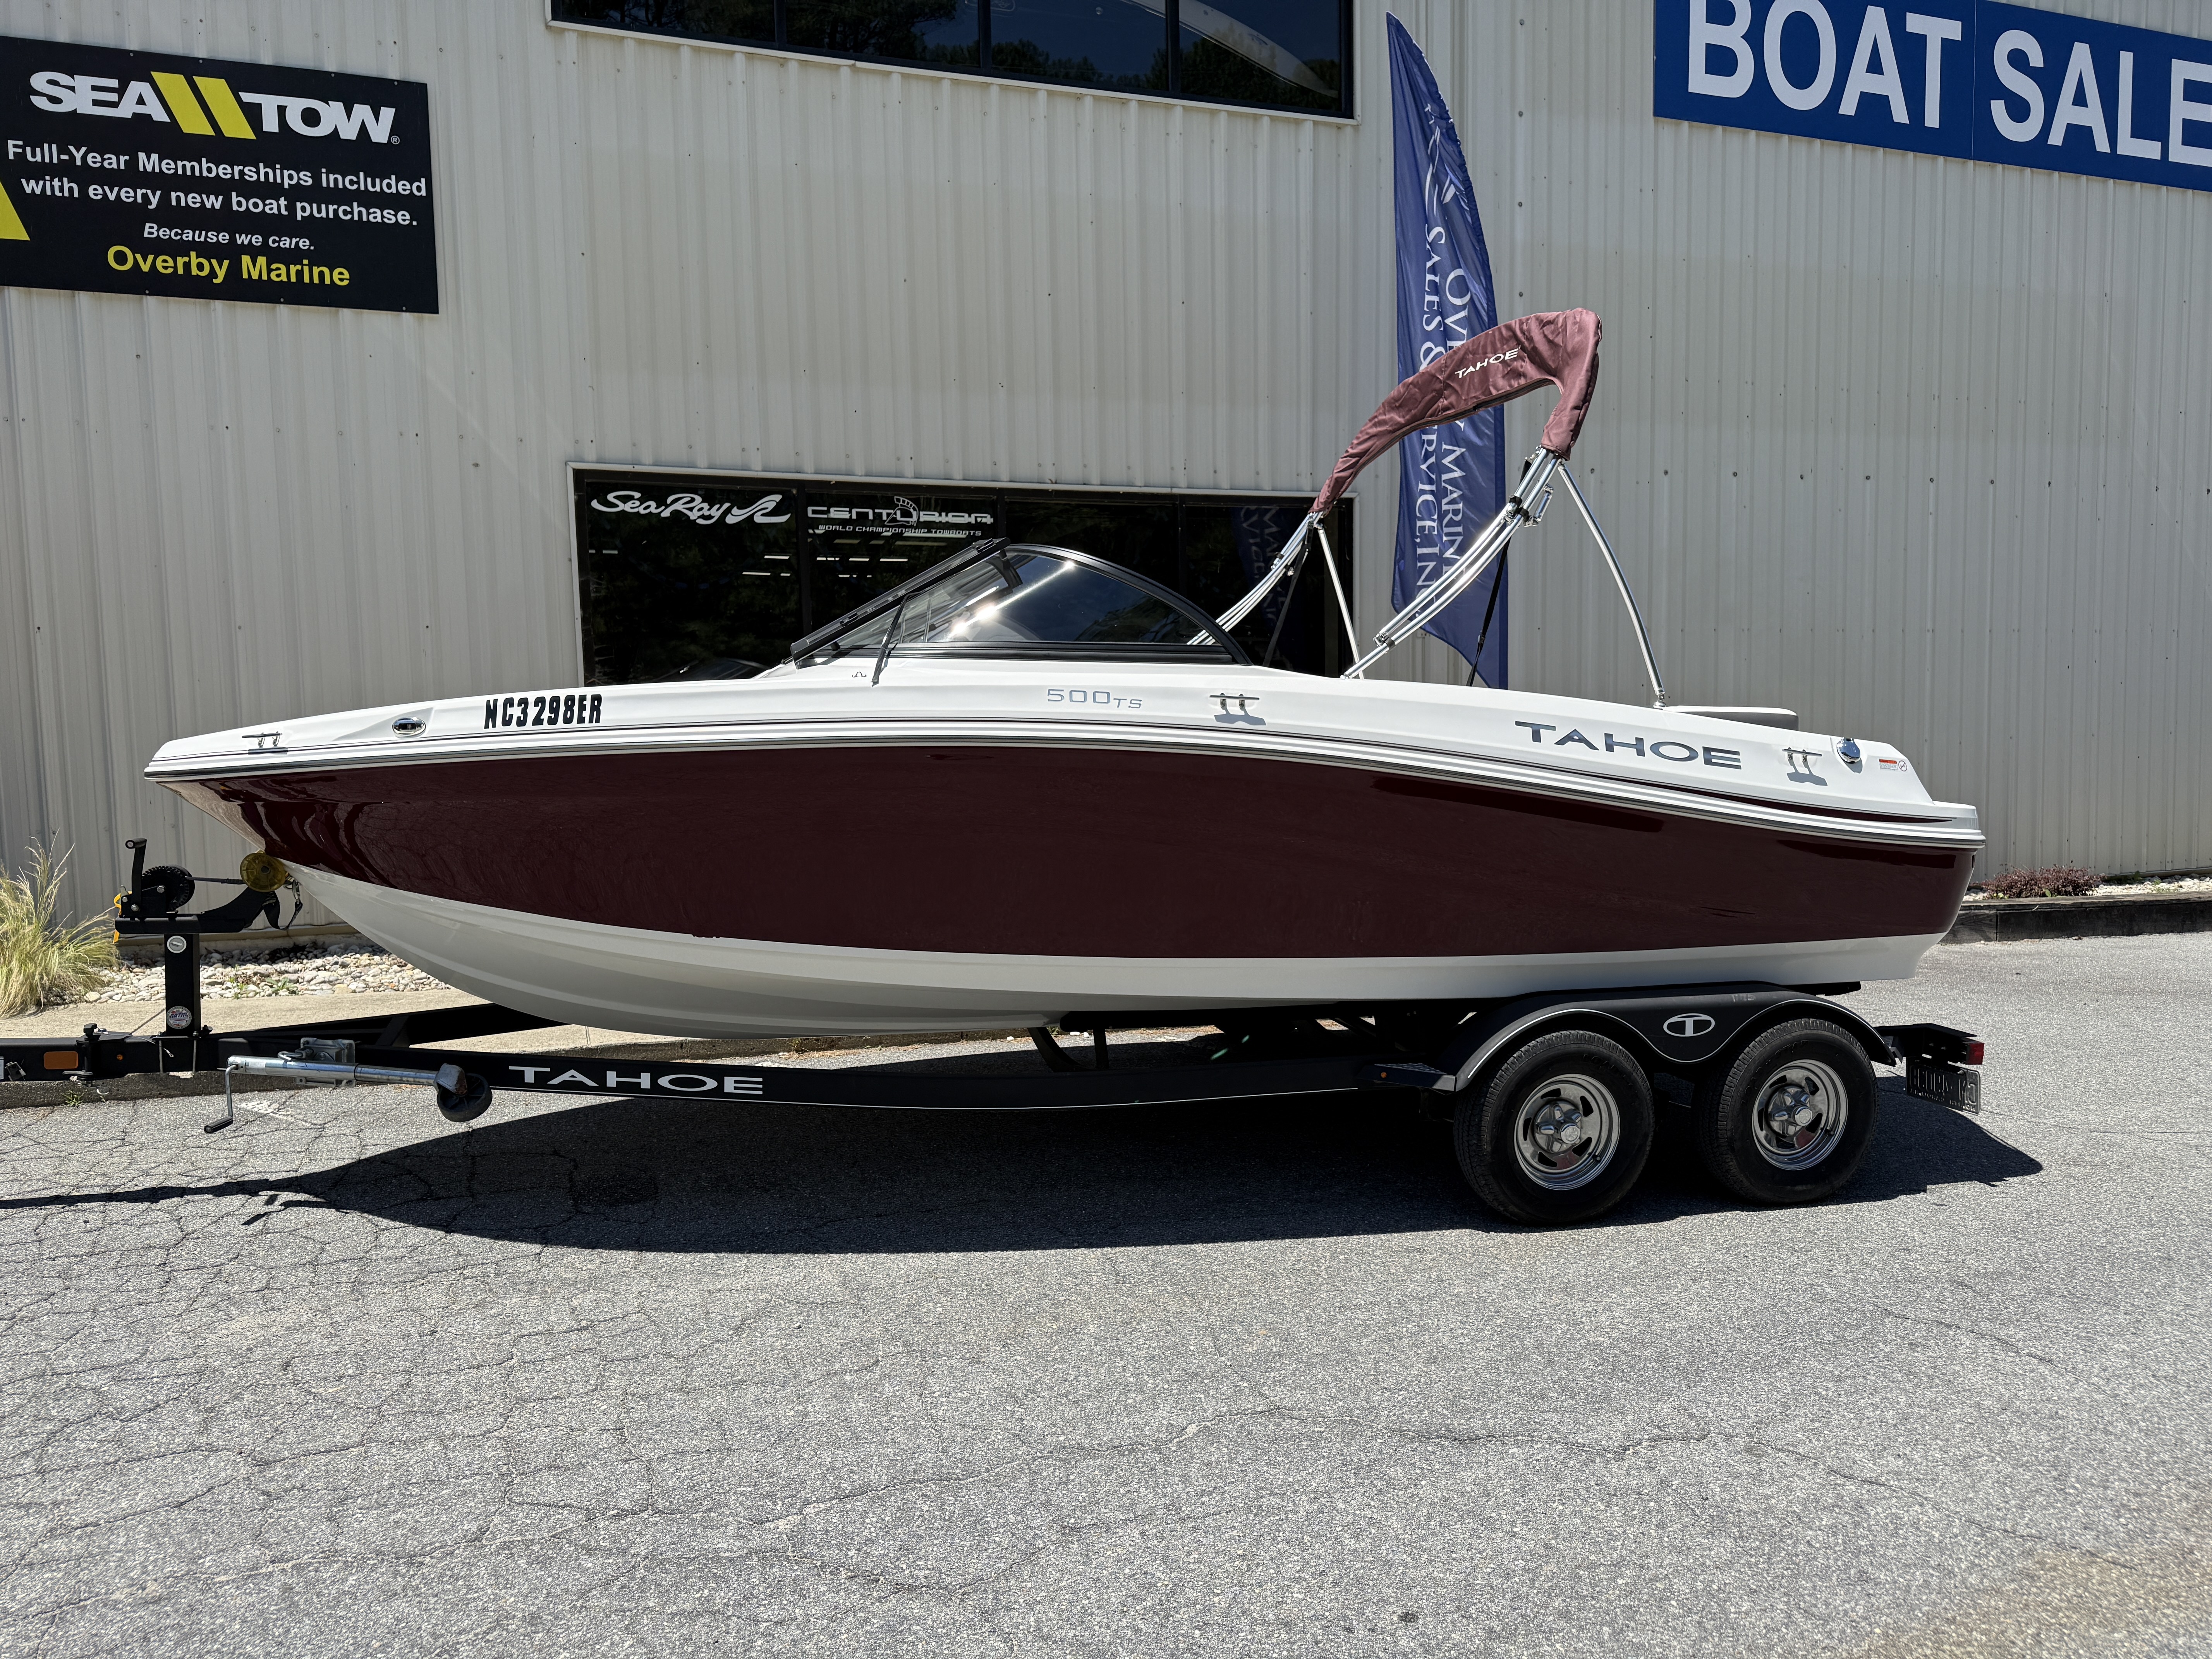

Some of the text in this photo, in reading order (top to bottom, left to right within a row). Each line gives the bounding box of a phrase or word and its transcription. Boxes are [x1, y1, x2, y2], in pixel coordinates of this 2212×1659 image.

[1688, 0, 2212, 168] BOAT SALE
[29, 71, 396, 144] SEA TOW
[7, 140, 426, 197] Full-Year Memberships included
[21, 175, 417, 226] with every new boat purchase.
[143, 222, 314, 250] Because we care.
[107, 245, 350, 286] Overby Marine
[1422, 223, 1446, 331] SALES
[1454, 348, 1519, 378] TAHOE
[591, 490, 731, 525] Sea Ray
[807, 506, 991, 524] CENTURION
[855, 526, 927, 534] CHAMPIONSHIP
[484, 694, 603, 729] NC3298ER
[1515, 720, 1742, 770] TAHOE
[508, 1065, 763, 1095] TAHOE
